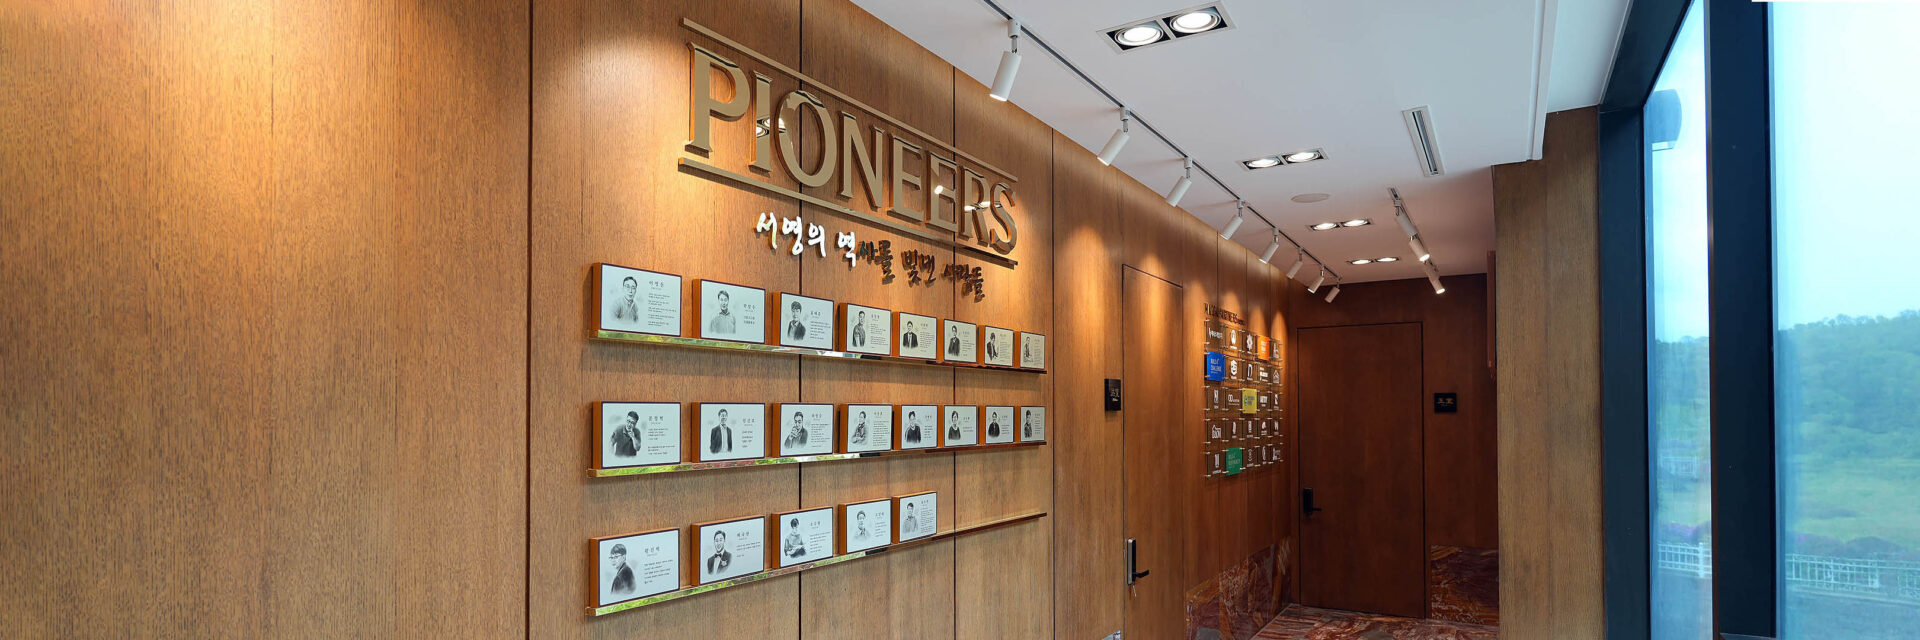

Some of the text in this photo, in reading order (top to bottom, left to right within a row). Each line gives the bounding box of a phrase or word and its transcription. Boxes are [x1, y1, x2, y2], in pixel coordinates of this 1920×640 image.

[685, 42, 1017, 255] PIONEERS
[756, 211, 985, 302] 서영의 역사를 빛낸 사람들
